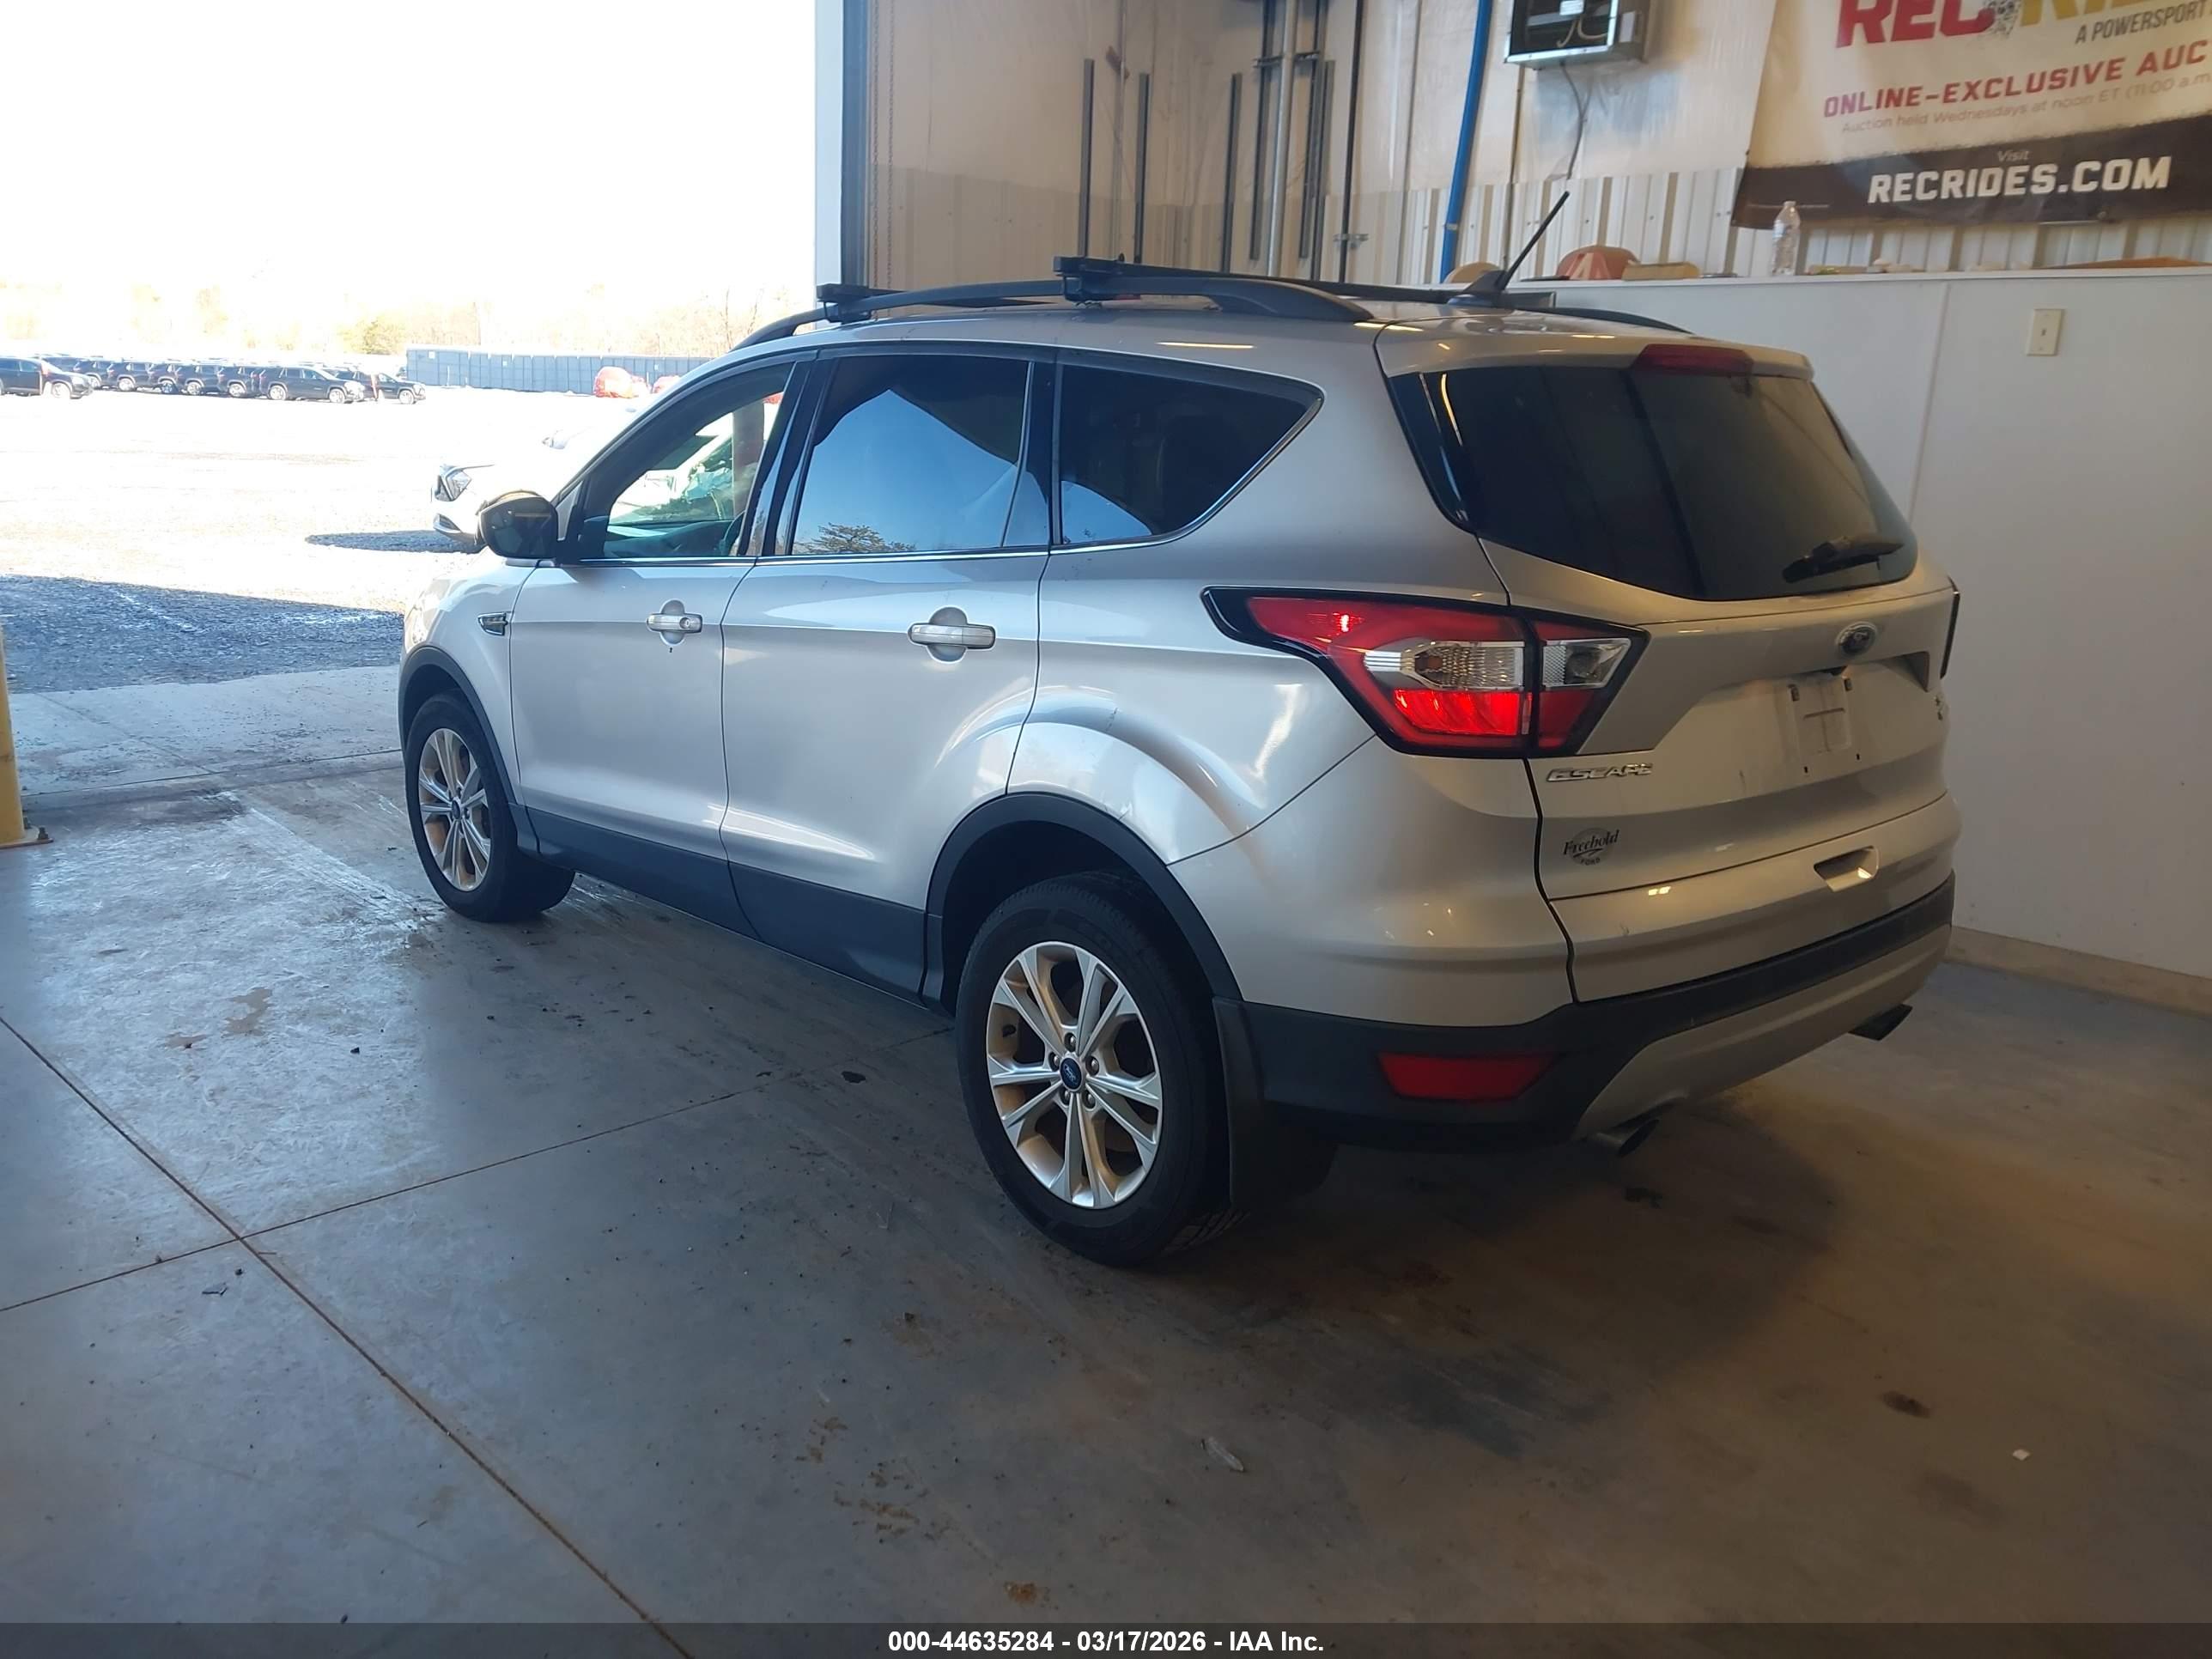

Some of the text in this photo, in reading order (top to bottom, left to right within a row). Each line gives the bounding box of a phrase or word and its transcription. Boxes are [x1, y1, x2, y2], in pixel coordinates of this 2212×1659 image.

[2075, 24, 2087, 44] A
[1824, 57, 2127, 118] ONLINE-EXCLUSIVE
[1842, 115, 1893, 133] Auction
[1896, 112, 1929, 125] held
[1933, 103, 2027, 124] Wednesdays
[2032, 100, 2048, 112] at
[2051, 94, 2094, 110] noon
[2099, 88, 2121, 102] ET
[1996, 149, 2030, 162] Visit
[1867, 155, 2172, 204] RECRIDES.COM
[1546, 763, 1653, 783] ESCAPE
[1563, 828, 1620, 855] Freehold
